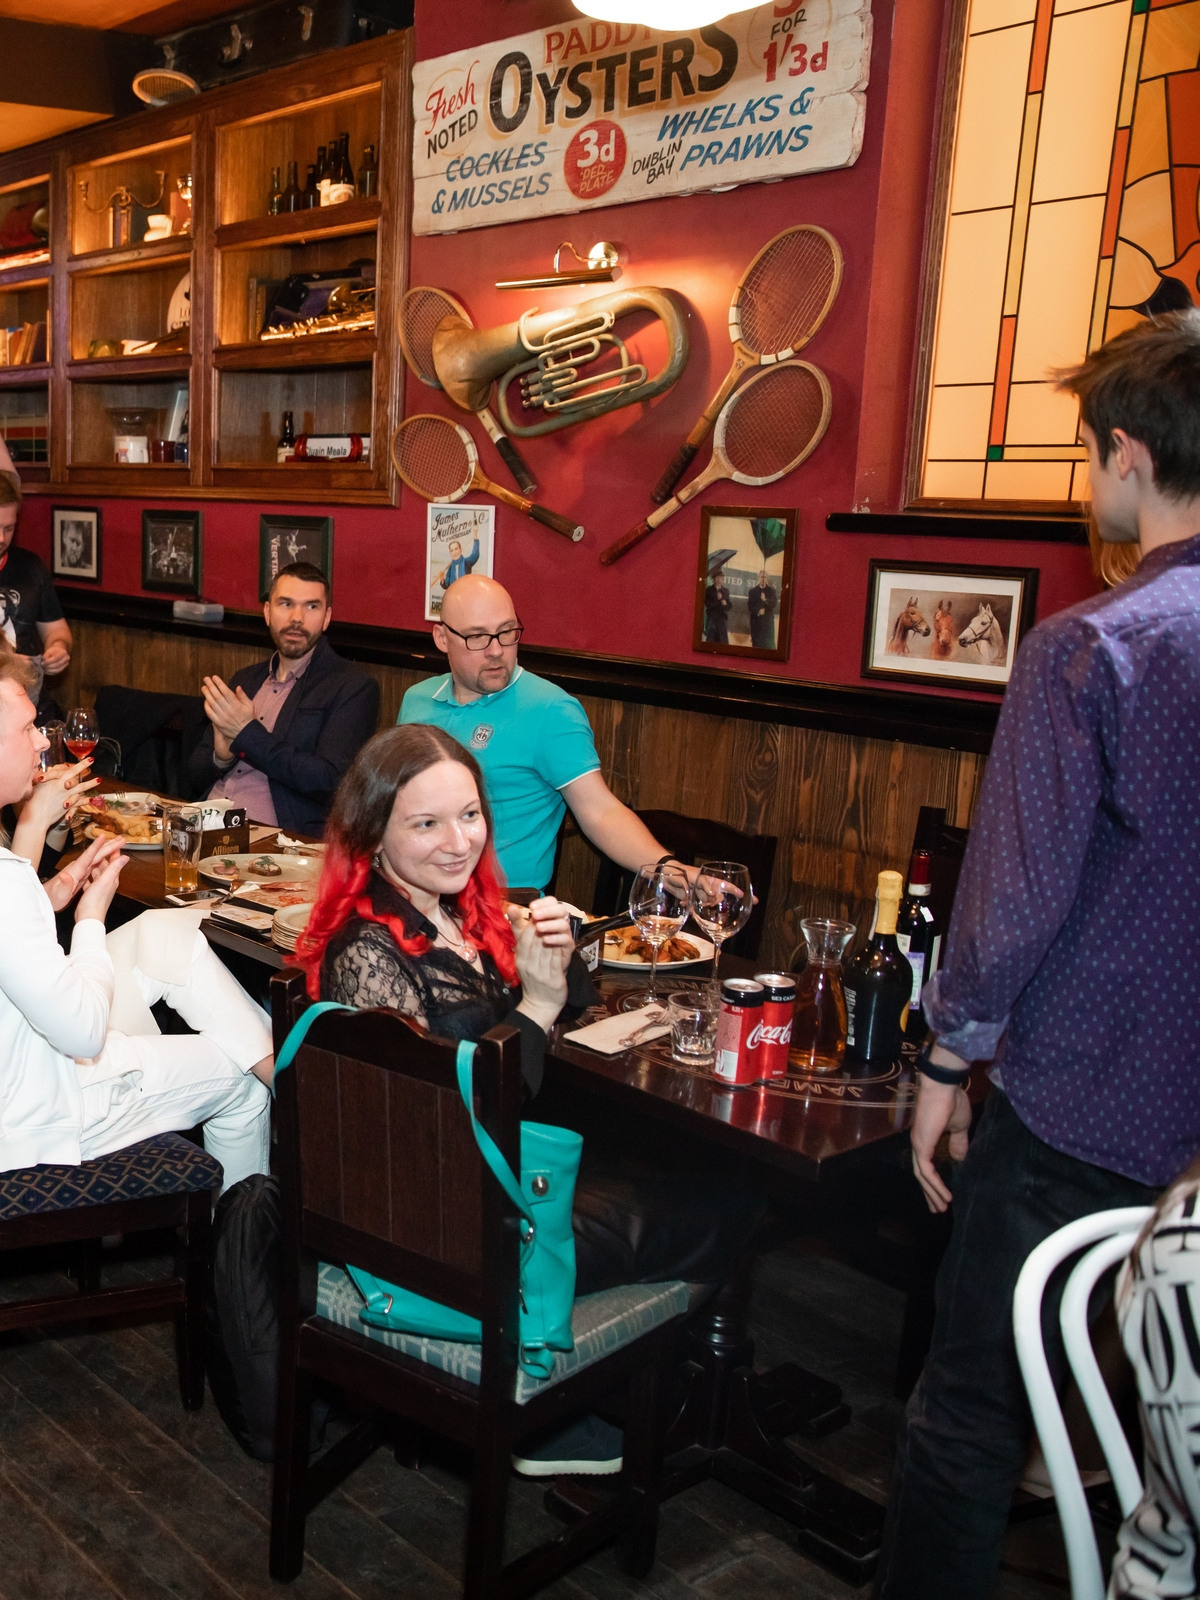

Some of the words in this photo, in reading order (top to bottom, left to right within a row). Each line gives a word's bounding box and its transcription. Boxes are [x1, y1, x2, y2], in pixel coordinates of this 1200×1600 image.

[769, 9, 808, 40] FOR
[424, 60, 480, 136] Fresh
[489, 24, 739, 133] OYSTERS
[426, 109, 479, 159] NOTED
[657, 94, 784, 142] WHELKS
[788, 86, 815, 117] &
[446, 141, 549, 183] COCKLES
[576, 128, 616, 168] 3d
[631, 138, 683, 176] DUBLIN
[679, 124, 814, 172] PRAWNS
[578, 169, 615, 194] PLATE
[646, 155, 676, 184] BAY
[430, 189, 447, 215] &
[446, 172, 553, 213] MUSSELS
